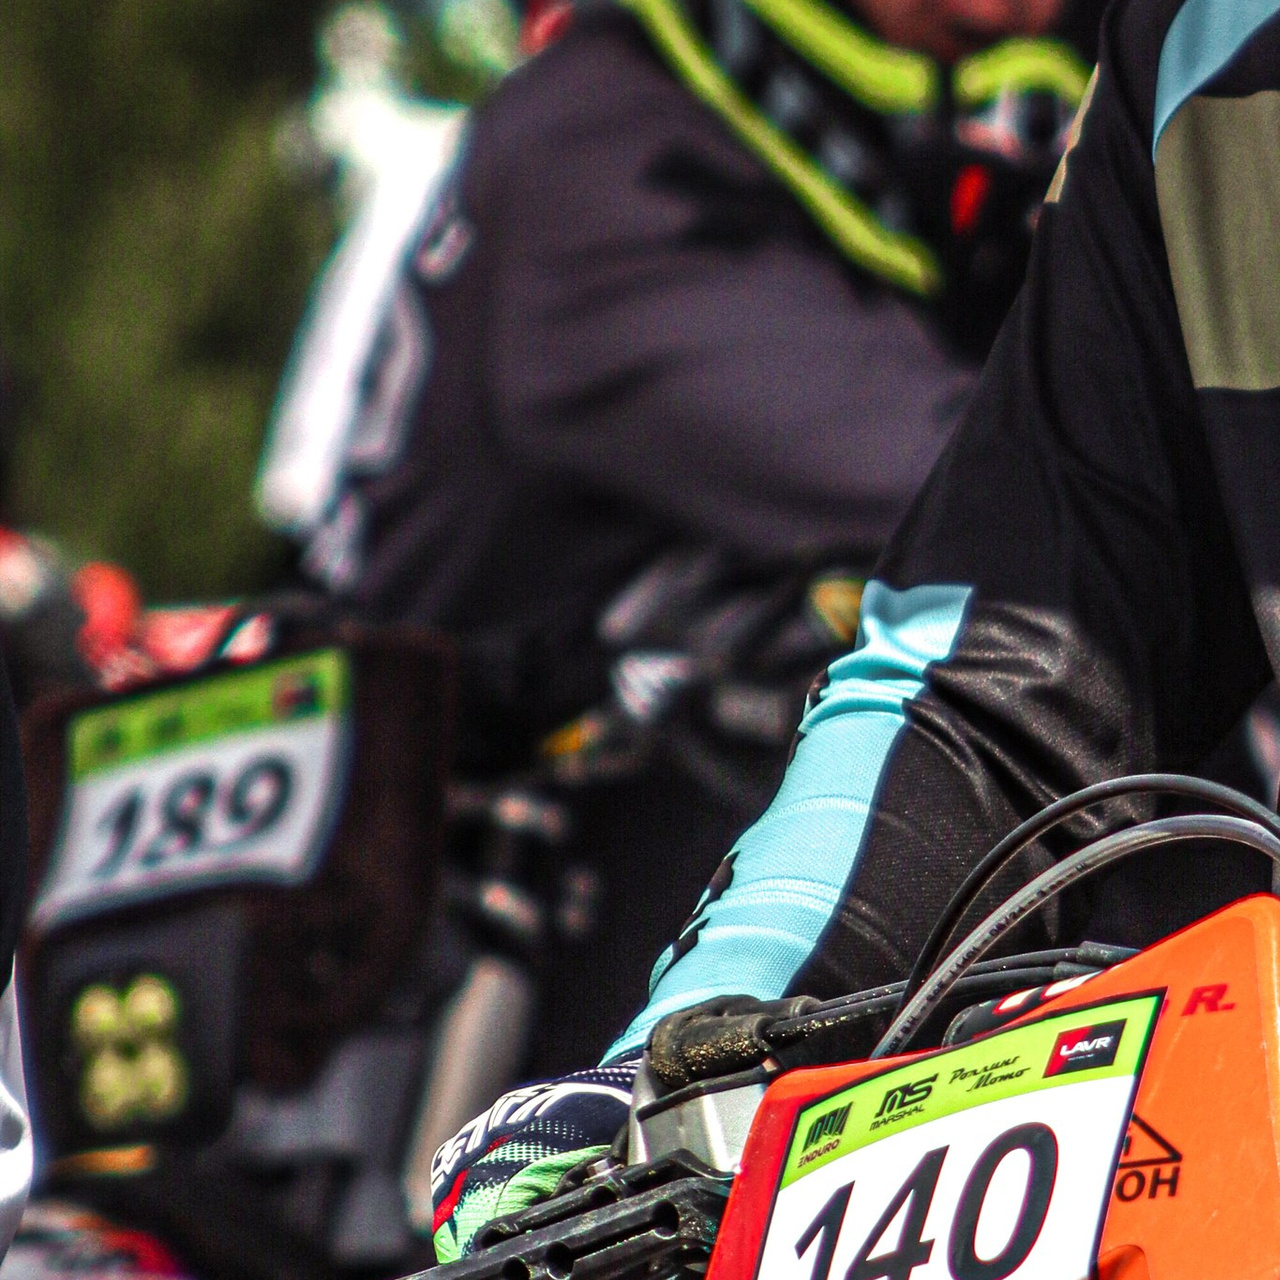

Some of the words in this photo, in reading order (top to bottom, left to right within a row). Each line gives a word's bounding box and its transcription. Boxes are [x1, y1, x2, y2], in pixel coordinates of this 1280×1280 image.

[95, 754, 293, 881] 189
[1059, 1035, 1112, 1057] LAVR
[869, 1104, 925, 1132] MARSHAL
[797, 1138, 841, 1169] ENDURO
